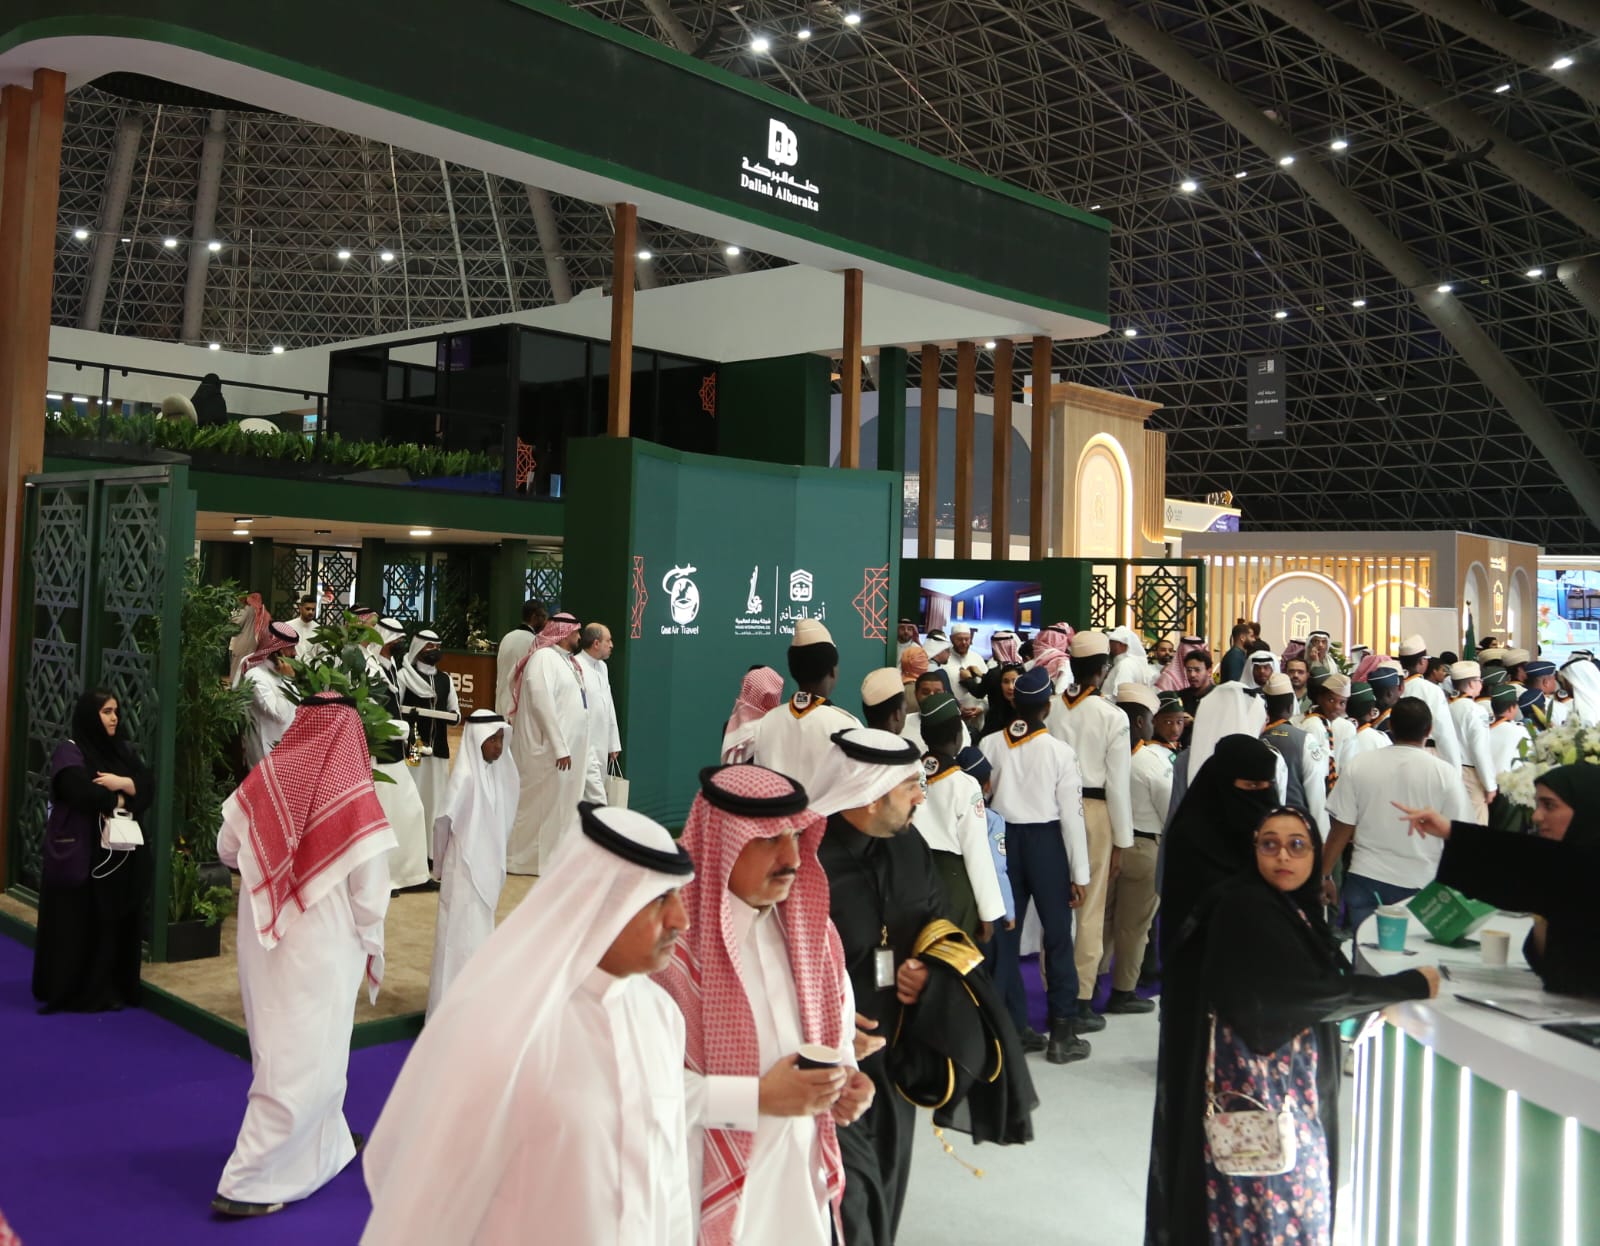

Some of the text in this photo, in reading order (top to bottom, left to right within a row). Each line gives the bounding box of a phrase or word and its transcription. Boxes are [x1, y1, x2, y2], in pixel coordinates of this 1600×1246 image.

[741, 173, 819, 212] Dallah Albaraka
[680, 625, 699, 635] Travel
